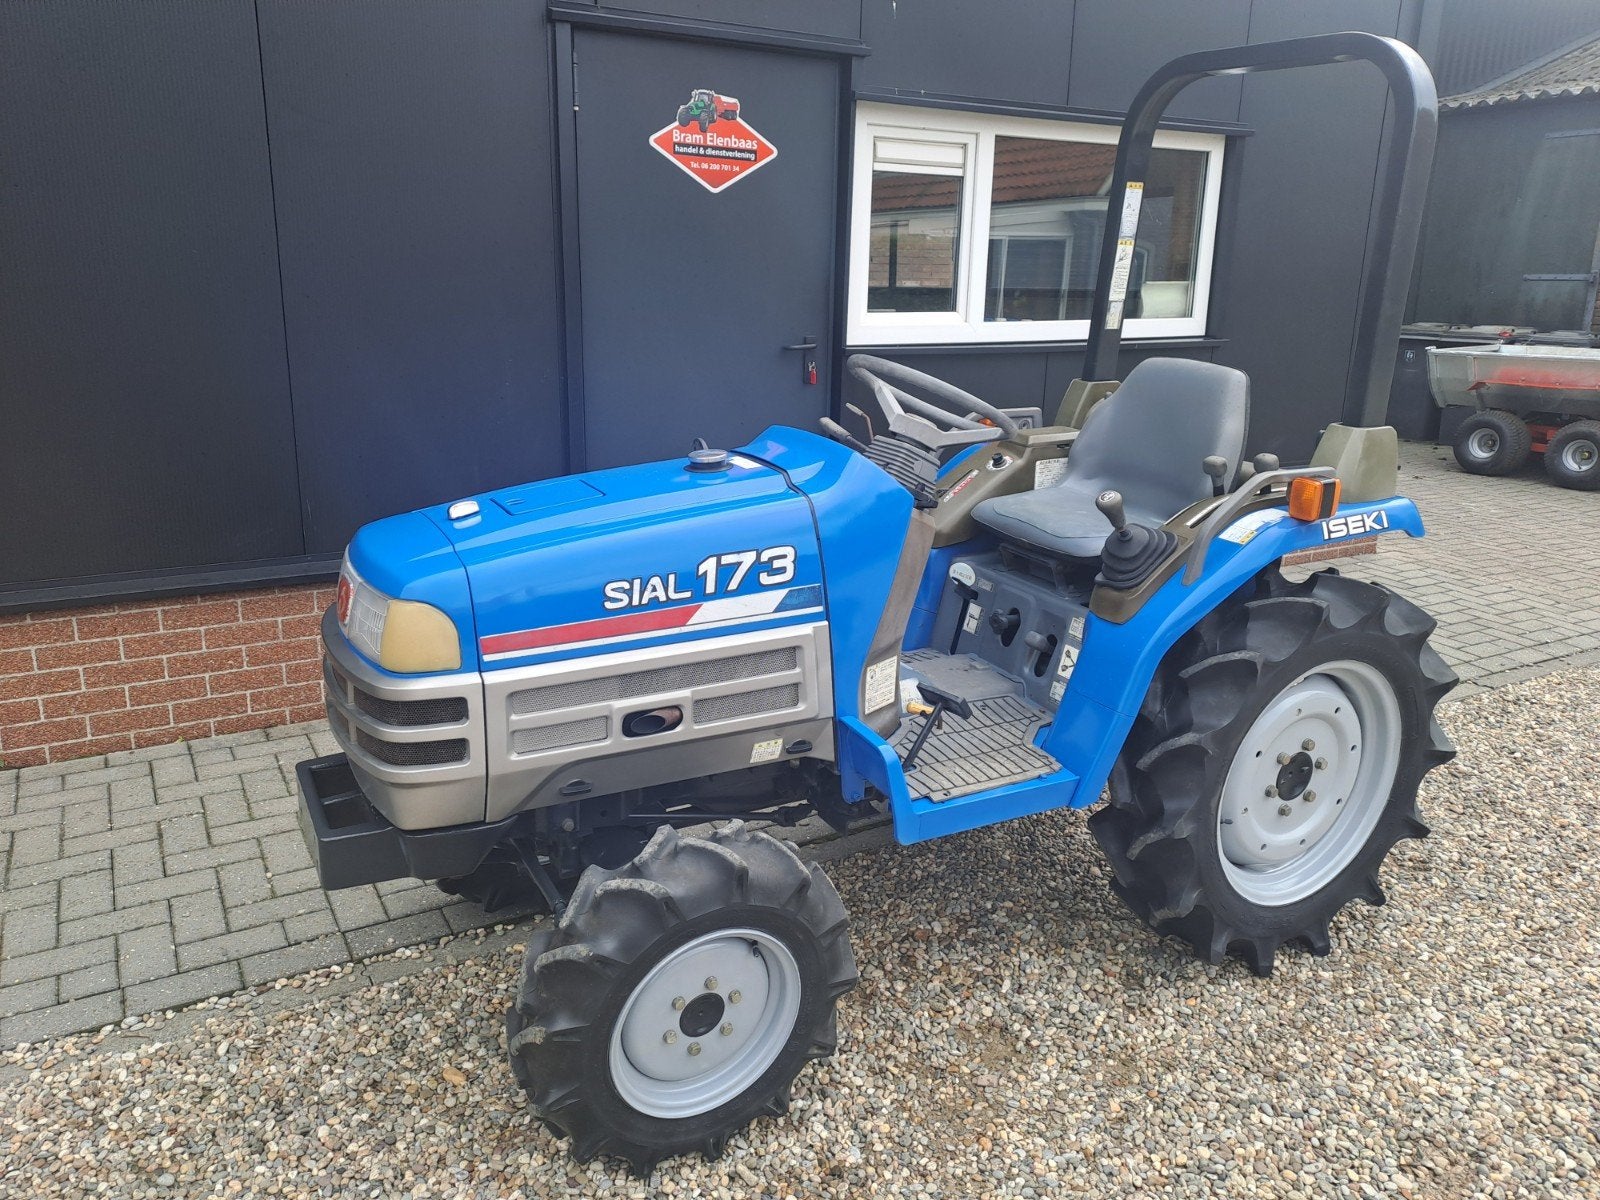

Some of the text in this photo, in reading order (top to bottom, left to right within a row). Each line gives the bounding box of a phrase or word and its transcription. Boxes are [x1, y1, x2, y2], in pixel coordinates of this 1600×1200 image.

[672, 129, 758, 150] Bram Elenbaas
[675, 144, 756, 161] handel & dienstverlening
[690, 161, 700, 169] Tel.
[700, 162, 709, 170] 06
[709, 163, 721, 171] 200
[1321, 510, 1389, 541] ISEKI
[603, 545, 797, 610] SIAL 173
